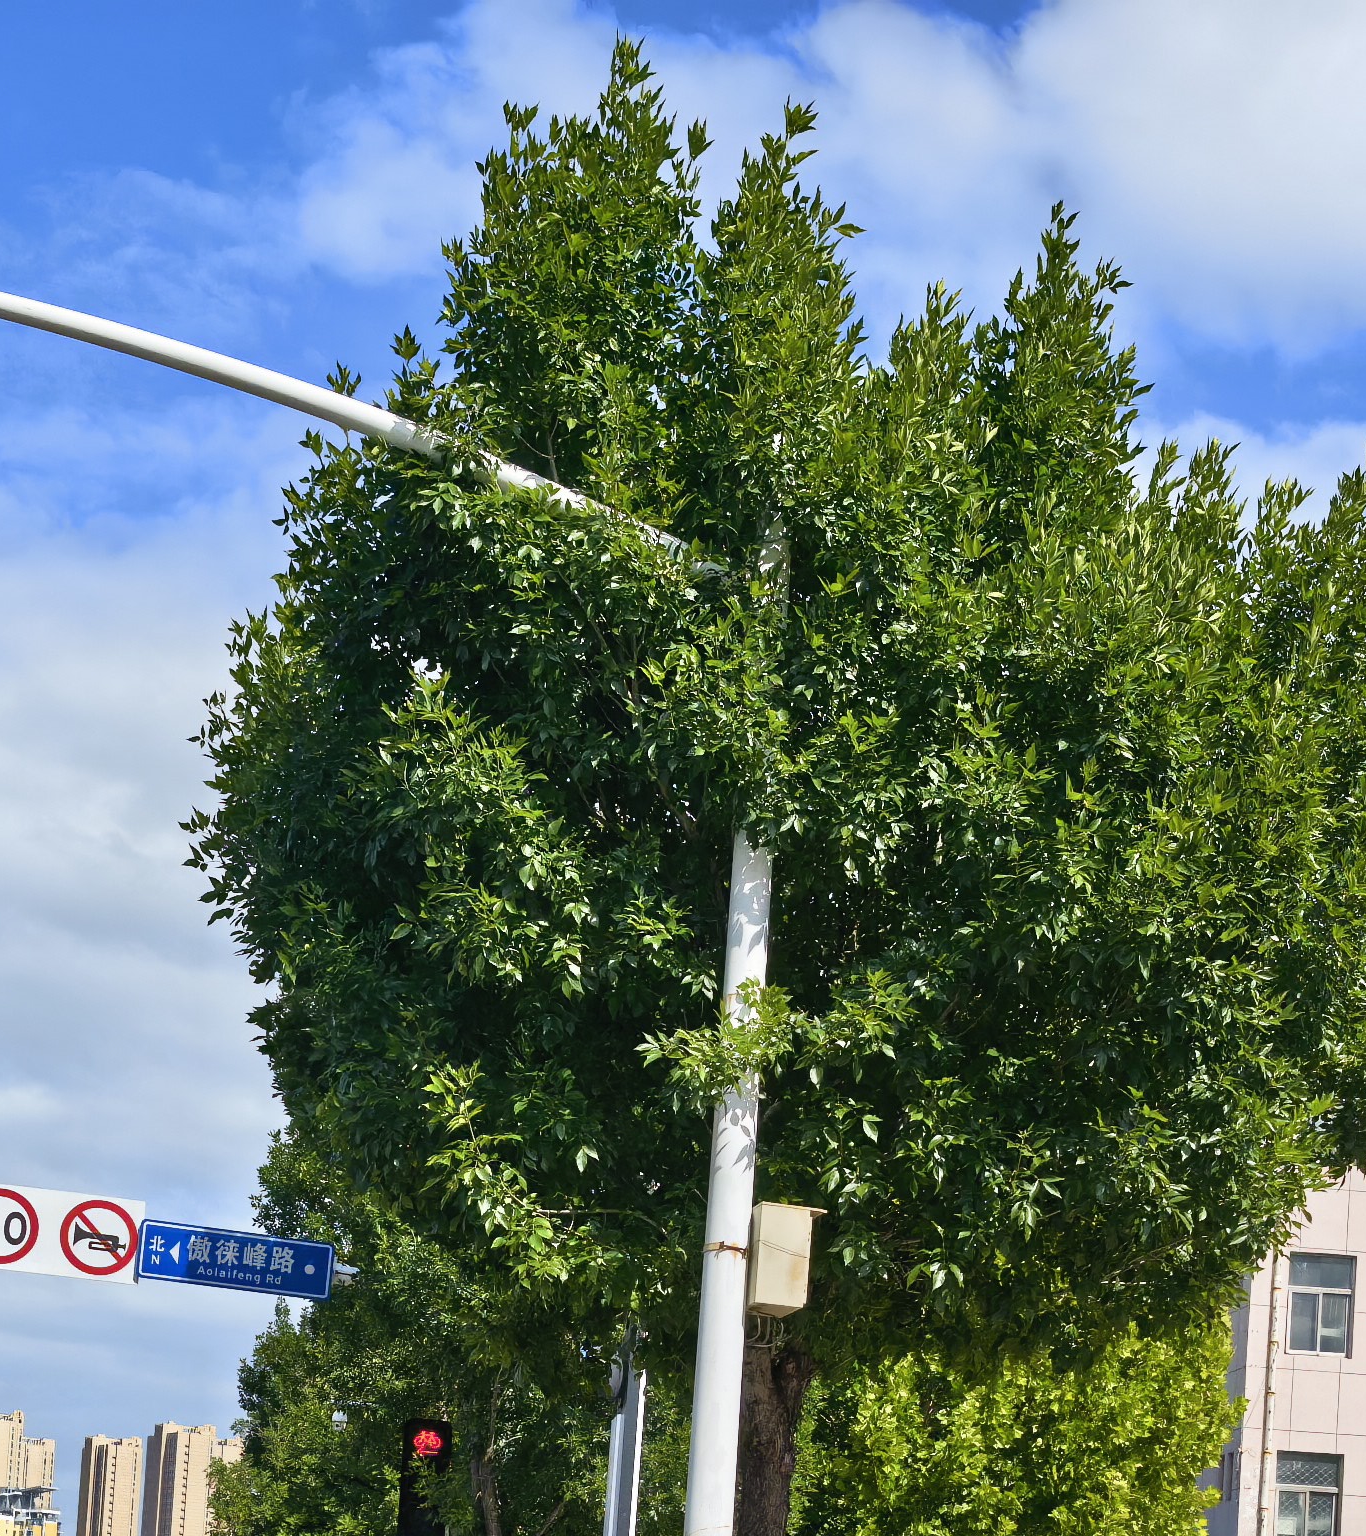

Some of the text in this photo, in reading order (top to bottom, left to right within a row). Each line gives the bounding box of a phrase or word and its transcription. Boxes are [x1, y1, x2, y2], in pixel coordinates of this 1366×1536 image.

[149, 1235, 165, 1252] 北
[150, 1254, 160, 1265] N
[187, 1234, 295, 1273] 傲徕峰路
[197, 1265, 282, 1285] Aolaifeng Rd
